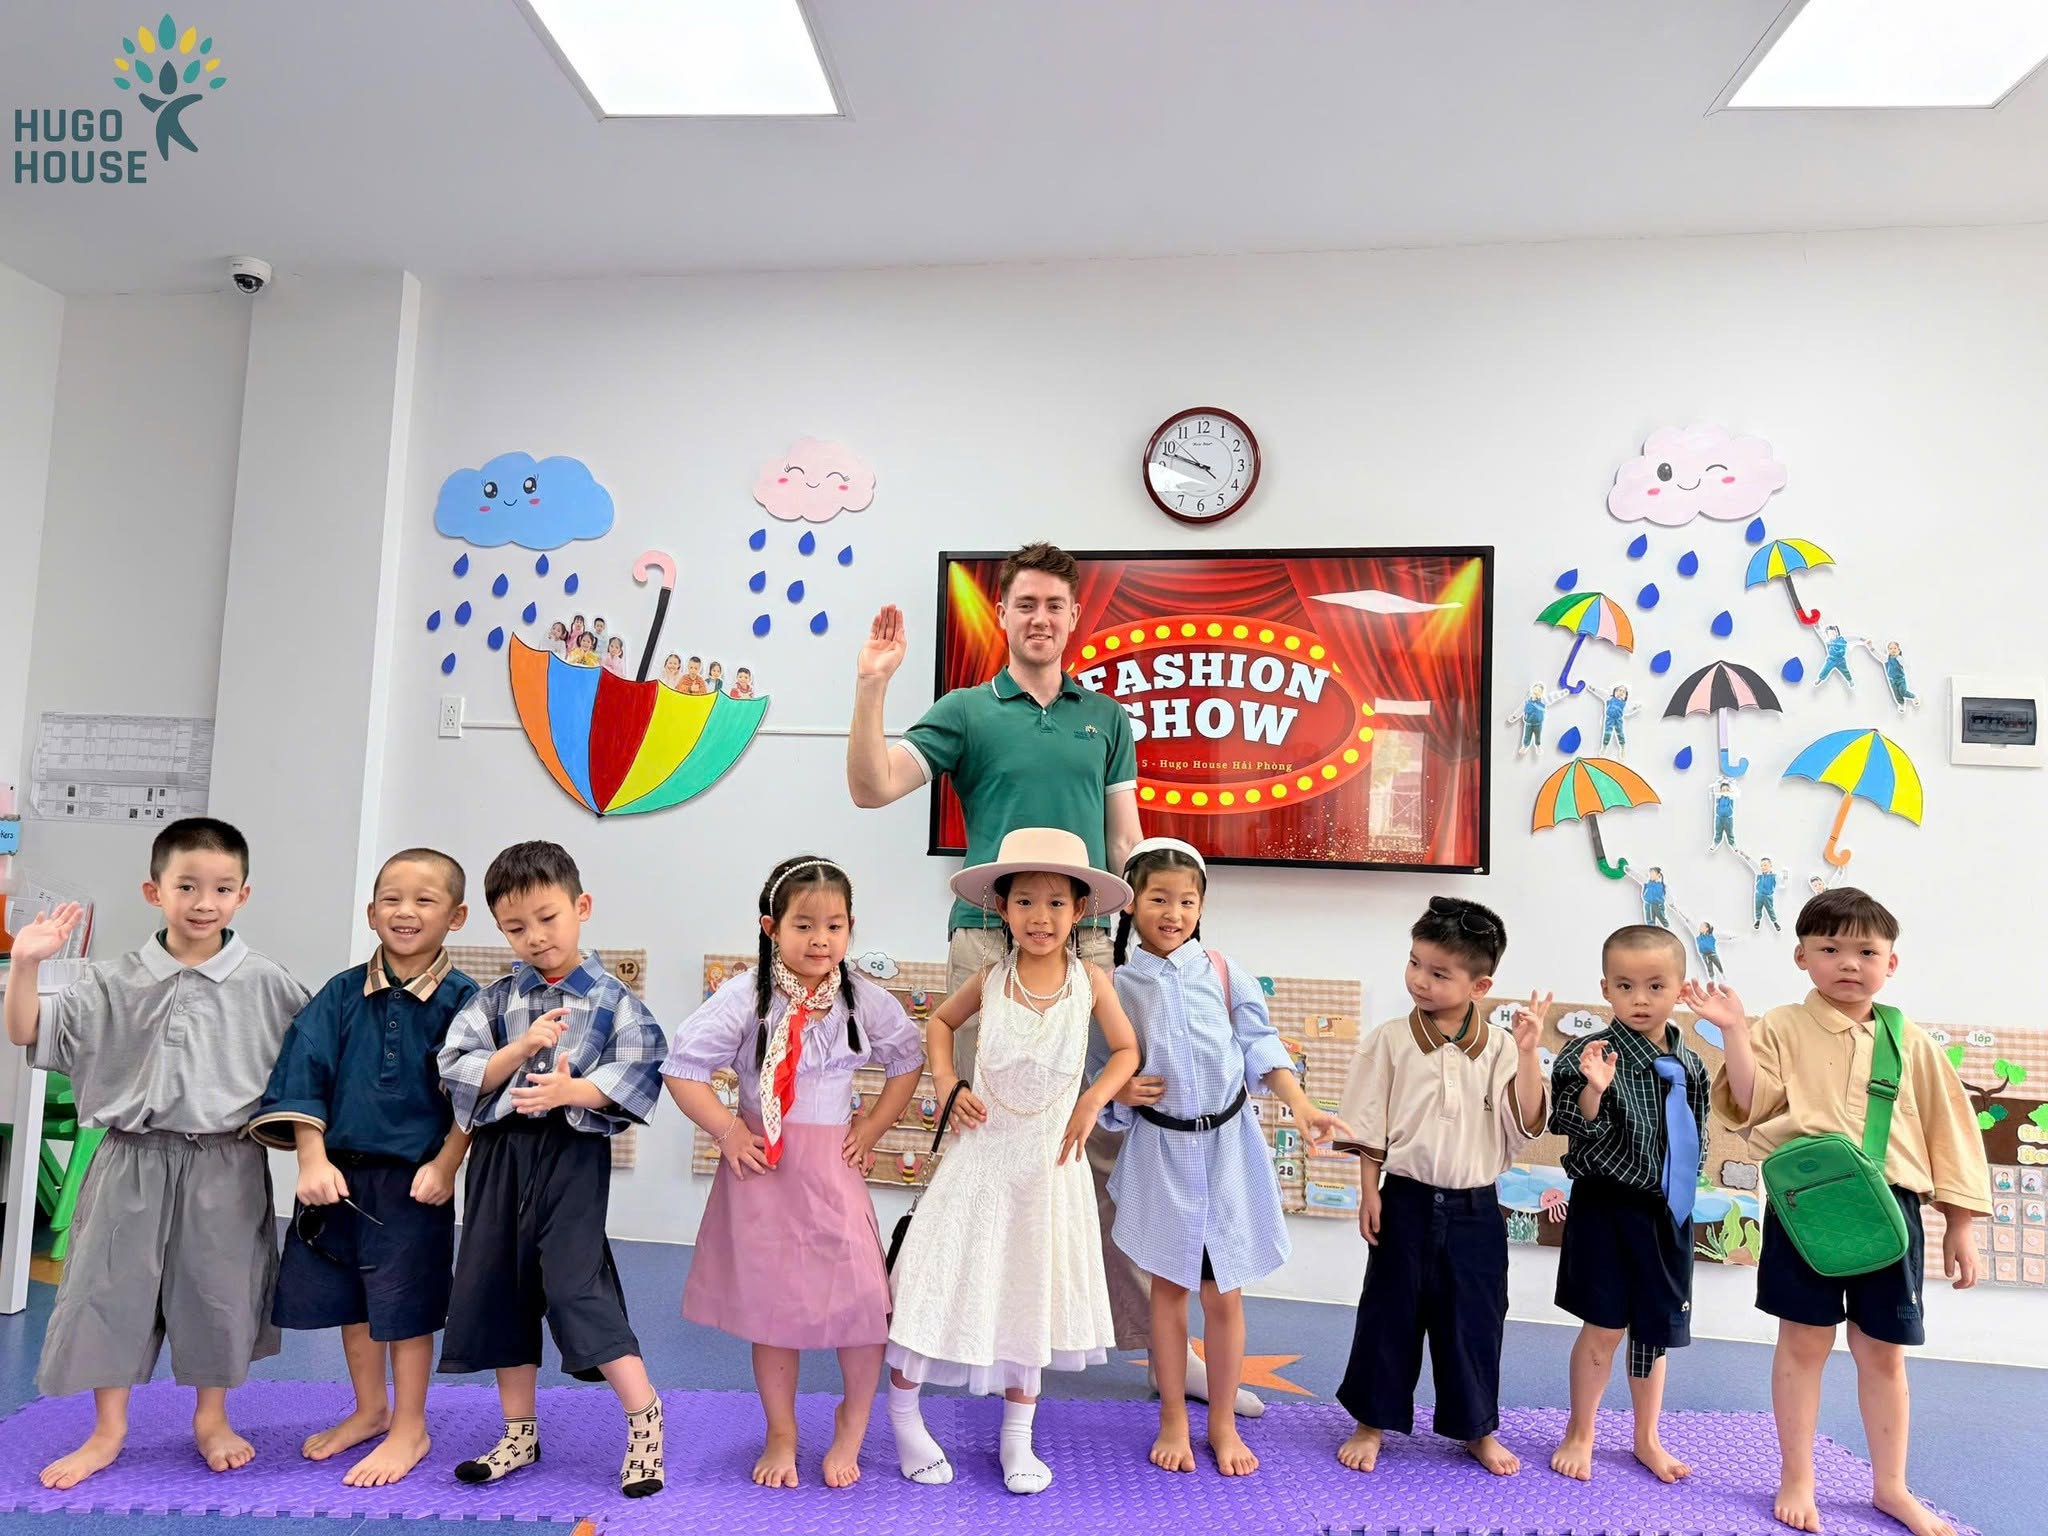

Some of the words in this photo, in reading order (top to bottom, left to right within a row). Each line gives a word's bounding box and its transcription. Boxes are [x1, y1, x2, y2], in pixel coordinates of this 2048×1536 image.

[1178, 426, 1188, 439] 11
[1197, 421, 1210, 434] 12
[1220, 426, 1225, 438] 1
[1162, 441, 1176, 454] 10
[1232, 439, 1241, 452] 2
[1237, 459, 1245, 472] 3
[1231, 478, 1239, 491] 4
[1177, 494, 1185, 508] 7
[1196, 499, 1205, 512] 6
[1216, 493, 1225, 506] 5
[1077, 652, 1331, 704] FASHION
[1120, 698, 1299, 746] SHOW
[1159, 759, 1189, 769] Hugo
[1193, 760, 1228, 769] House
[1256, 761, 1293, 773] Phòng
[619, 963, 634, 974] 12
[870, 961, 885, 971] cô
[1574, 1017, 1593, 1029] bé
[1974, 1033, 1992, 1044] lớp
[1279, 1165, 1293, 1176] 28
